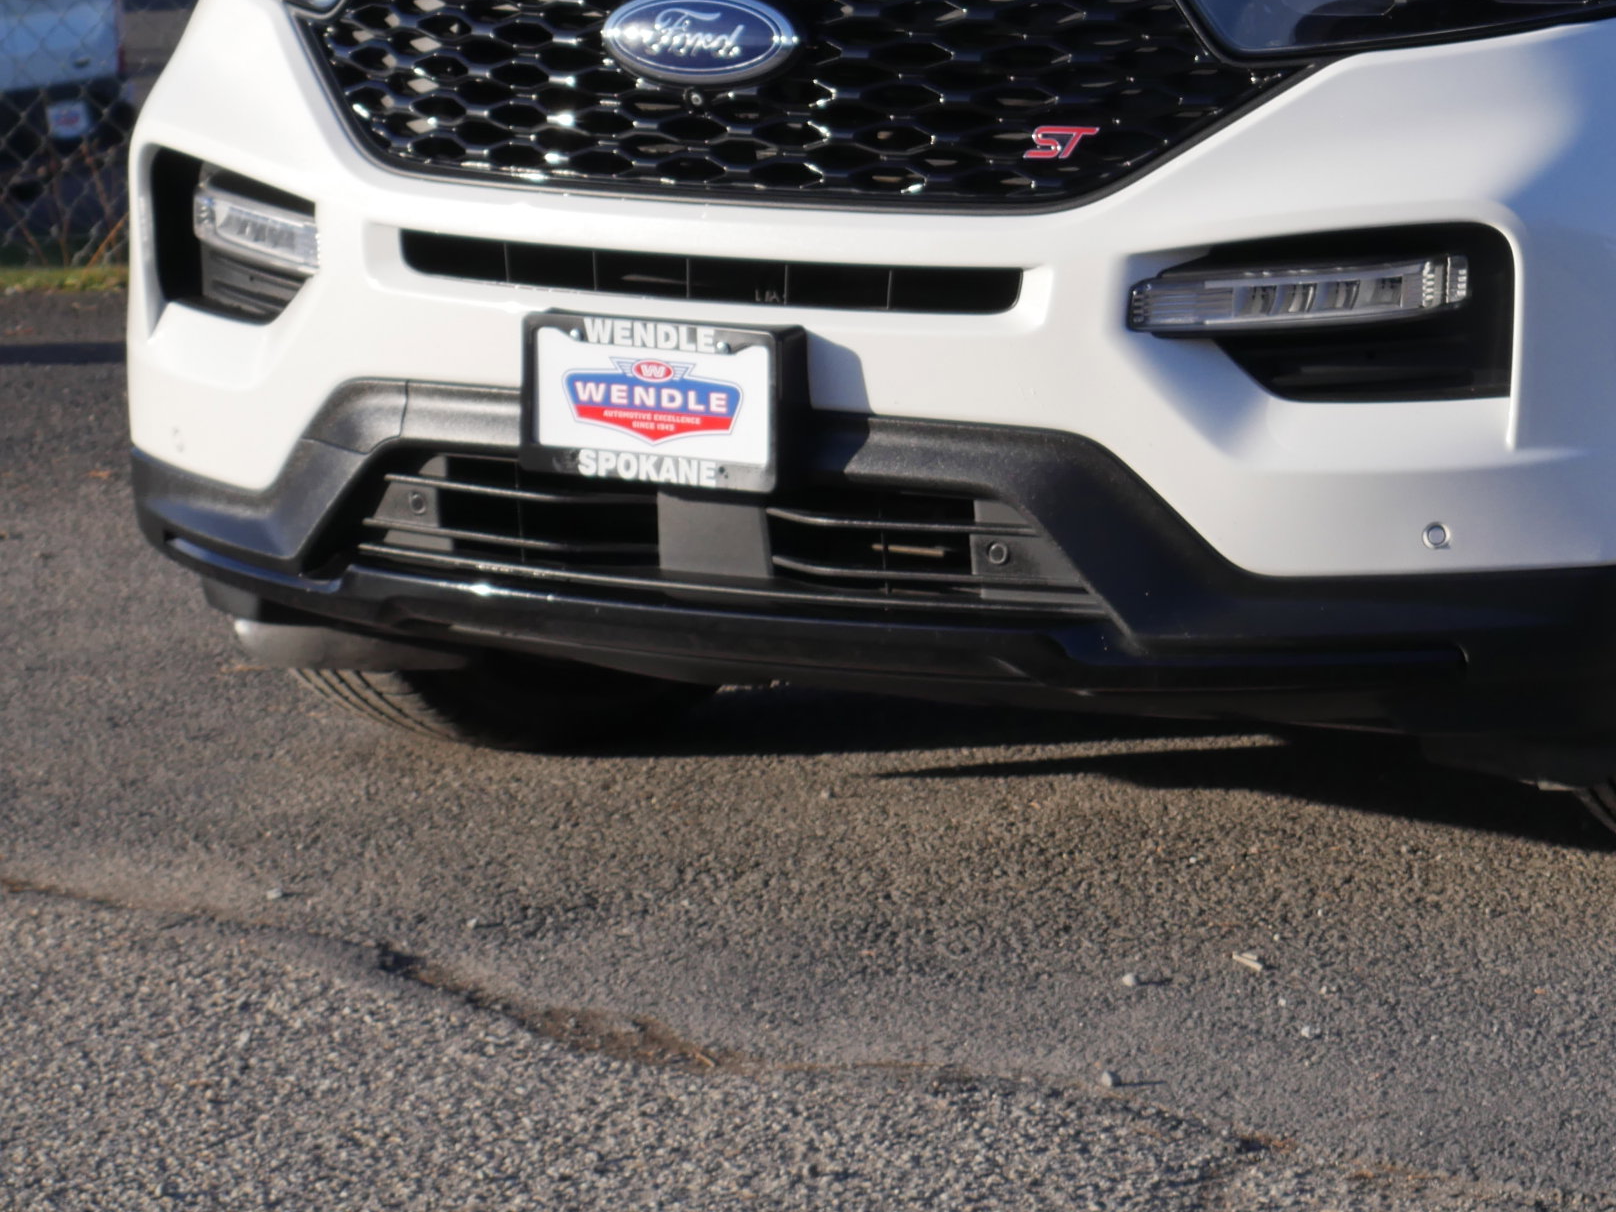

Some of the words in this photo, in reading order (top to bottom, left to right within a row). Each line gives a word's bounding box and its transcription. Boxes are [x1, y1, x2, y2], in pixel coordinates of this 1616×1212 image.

[645, 7, 745, 58] Ford
[1022, 125, 1100, 159] ST
[583, 316, 716, 354] WENDLE
[640, 364, 667, 378] W
[574, 381, 728, 414] WENDLE
[603, 409, 651, 421] AUTOMOTIVE
[653, 411, 701, 425] EXCELLENCE
[632, 421, 655, 430] SINCE
[577, 448, 717, 488] SPOKANE
